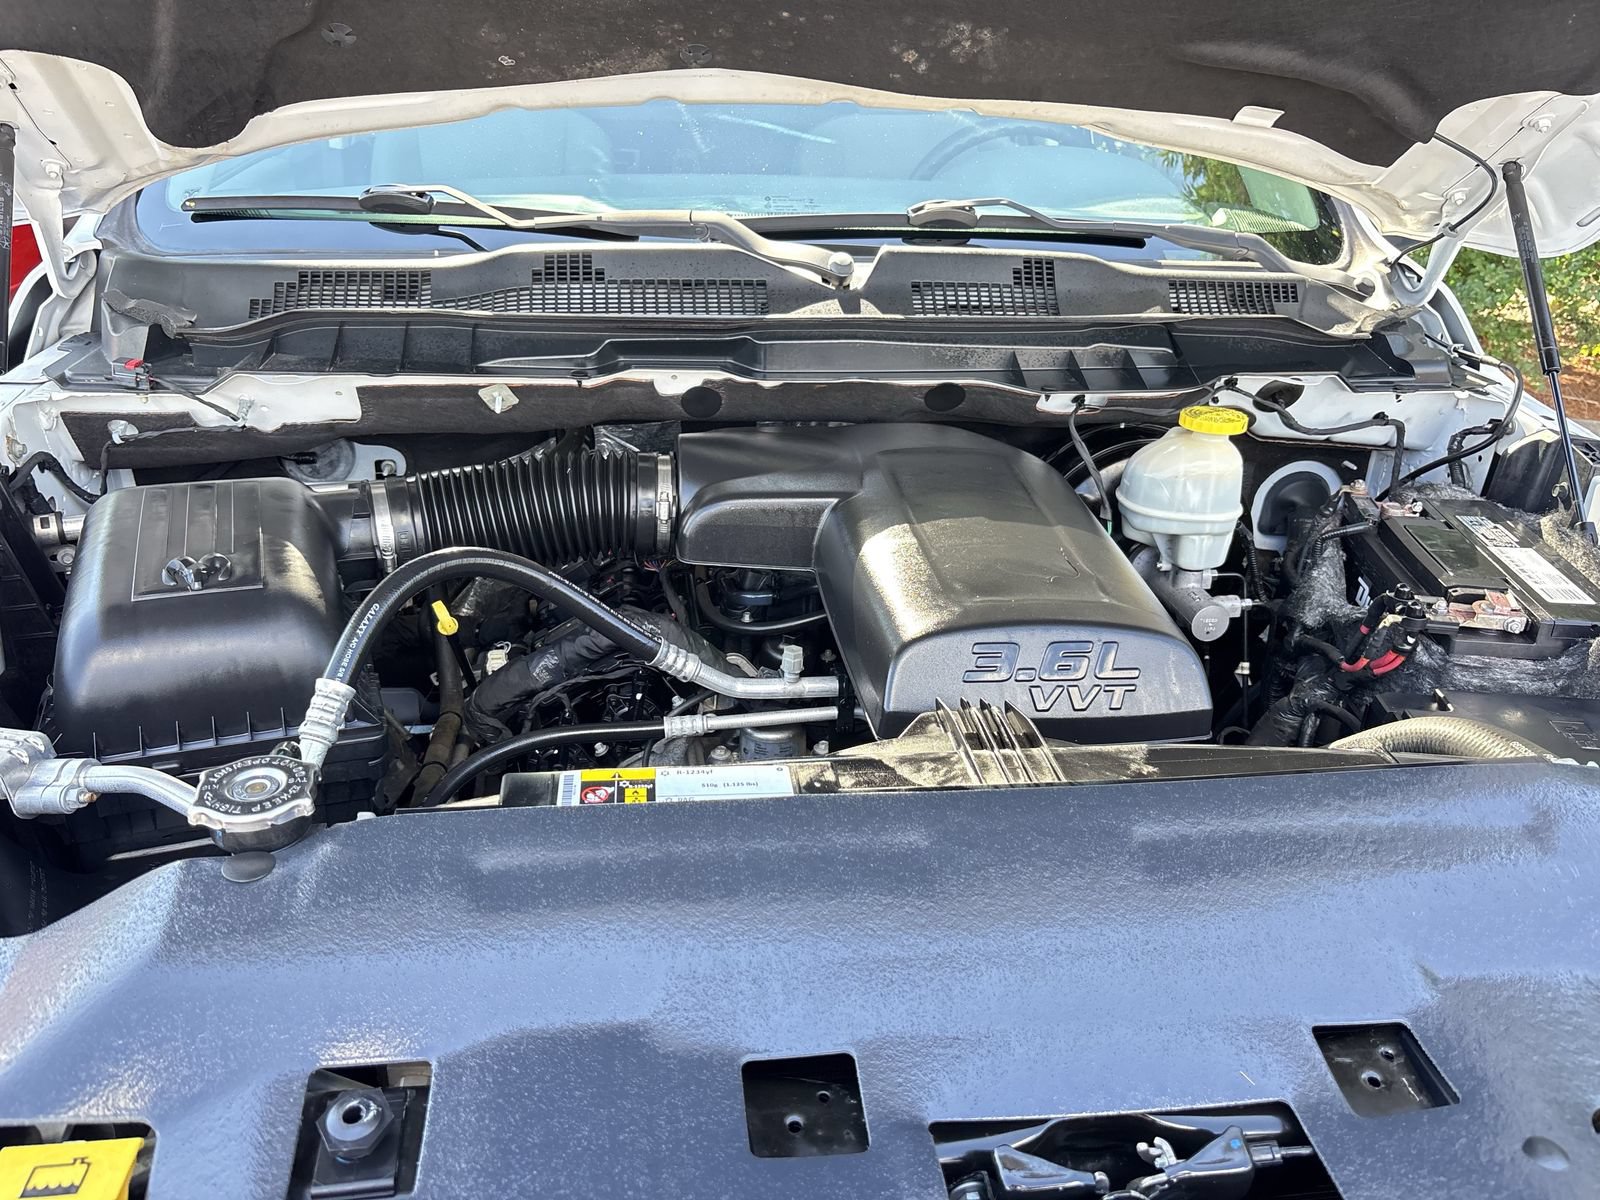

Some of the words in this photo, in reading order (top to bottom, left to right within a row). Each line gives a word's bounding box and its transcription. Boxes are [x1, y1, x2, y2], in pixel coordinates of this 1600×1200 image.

[356, 603, 380, 637] GALAXY
[341, 648, 354, 667] HOSE
[962, 640, 1142, 684] 3.6L
[1028, 683, 1138, 712] VVT
[272, 759, 298, 768] NOT
[252, 792, 288, 812] KEEP
